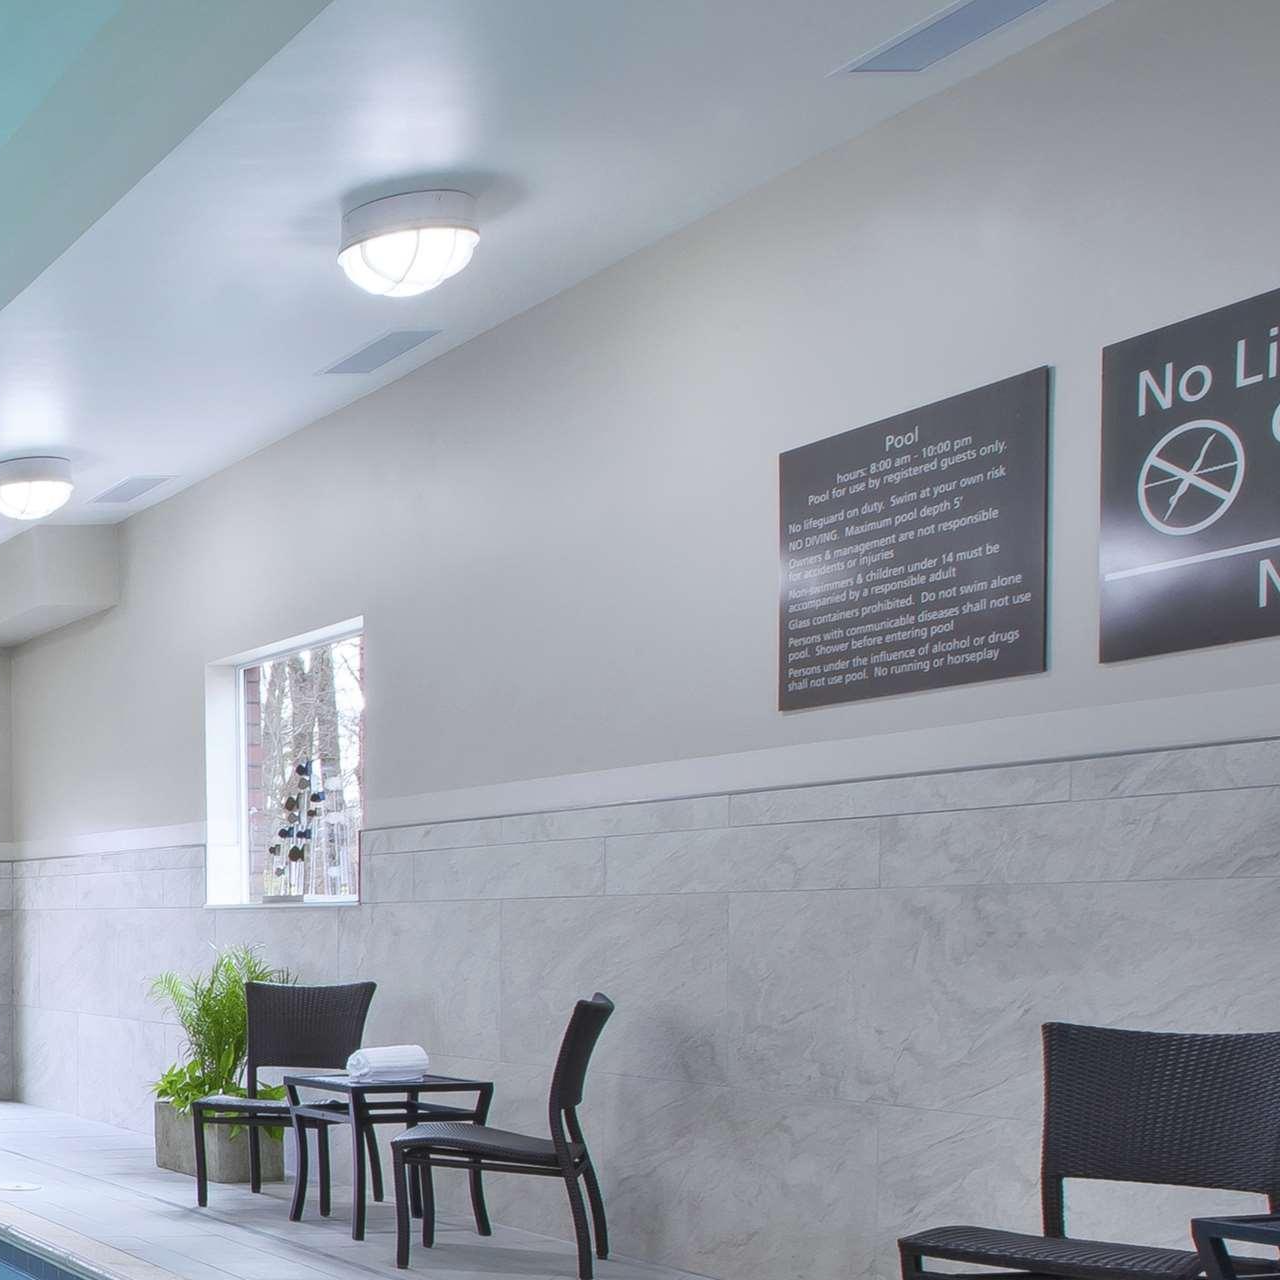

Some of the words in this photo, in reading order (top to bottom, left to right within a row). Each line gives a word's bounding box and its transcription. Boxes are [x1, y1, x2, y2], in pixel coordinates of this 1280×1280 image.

[1138, 362, 1212, 417] No
[869, 458, 891, 474] 8:00
[894, 454, 911, 466] am
[921, 439, 950, 458] 10:00
[953, 436, 972, 451] pm
[885, 425, 918, 451] Pool
[808, 489, 829, 505] Pool
[831, 487, 846, 498] for
[848, 482, 865, 494] use
[868, 478, 880, 489] by
[883, 458, 937, 484] registered
[940, 449, 976, 470] guests
[979, 439, 1007, 456] only.
[788, 522, 801, 534] No
[803, 509, 844, 530] lifeguard
[846, 507, 859, 518] on
[890, 491, 917, 507] Swim
[919, 487, 930, 498] at
[932, 480, 957, 498] your
[959, 473, 983, 487] own
[986, 464, 1006, 480] risk
[789, 539, 802, 551] NO
[844, 517, 892, 536] Maximum
[894, 507, 917, 526] pool
[919, 500, 950, 517] depth
[824, 549, 831, 560] &
[833, 534, 896, 557] management
[898, 530, 914, 542] are
[916, 524, 935, 537] not
[937, 507, 999, 532] responsible
[788, 571, 801, 581] for
[846, 558, 856, 568] or
[859, 549, 894, 565] injuries
[848, 590, 860, 601] by
[862, 588, 868, 597] a
[870, 574, 926, 594] responsible
[928, 566, 955, 582] adult
[856, 573, 863, 584] &
[865, 565, 904, 582] children
[907, 557, 937, 572] under
[941, 551, 953, 564] 14
[956, 546, 982, 561] must
[985, 543, 1000, 555] be
[788, 618, 810, 630] Glass
[812, 608, 859, 625] containers
[920, 591, 936, 603] Do
[938, 586, 956, 599] not
[959, 580, 988, 595] swim
[990, 573, 1022, 588] alone
[788, 633, 821, 647] Persons
[823, 628, 843, 640] with
[845, 613, 915, 636] communicable
[917, 606, 959, 622] diseases
[961, 598, 987, 614] shall
[989, 595, 1009, 608] not
[1012, 592, 1031, 604] use
[788, 665, 821, 678] Persons
[823, 659, 850, 672] under
[852, 655, 868, 667] the
[870, 648, 915, 663] influence
[917, 642, 929, 655] of
[931, 635, 970, 653] alcohol
[973, 635, 985, 646] or
[987, 629, 1020, 643] drugs
[815, 642, 849, 656] Shower
[851, 636, 883, 649] before
[884, 627, 927, 643] entering
[930, 619, 954, 637] pool
[787, 679, 807, 692] shall
[809, 677, 825, 688] not
[827, 675, 843, 685] use
[873, 666, 888, 677] No
[890, 660, 930, 674] running
[932, 657, 944, 668] or
[946, 648, 999, 665] horseplay
